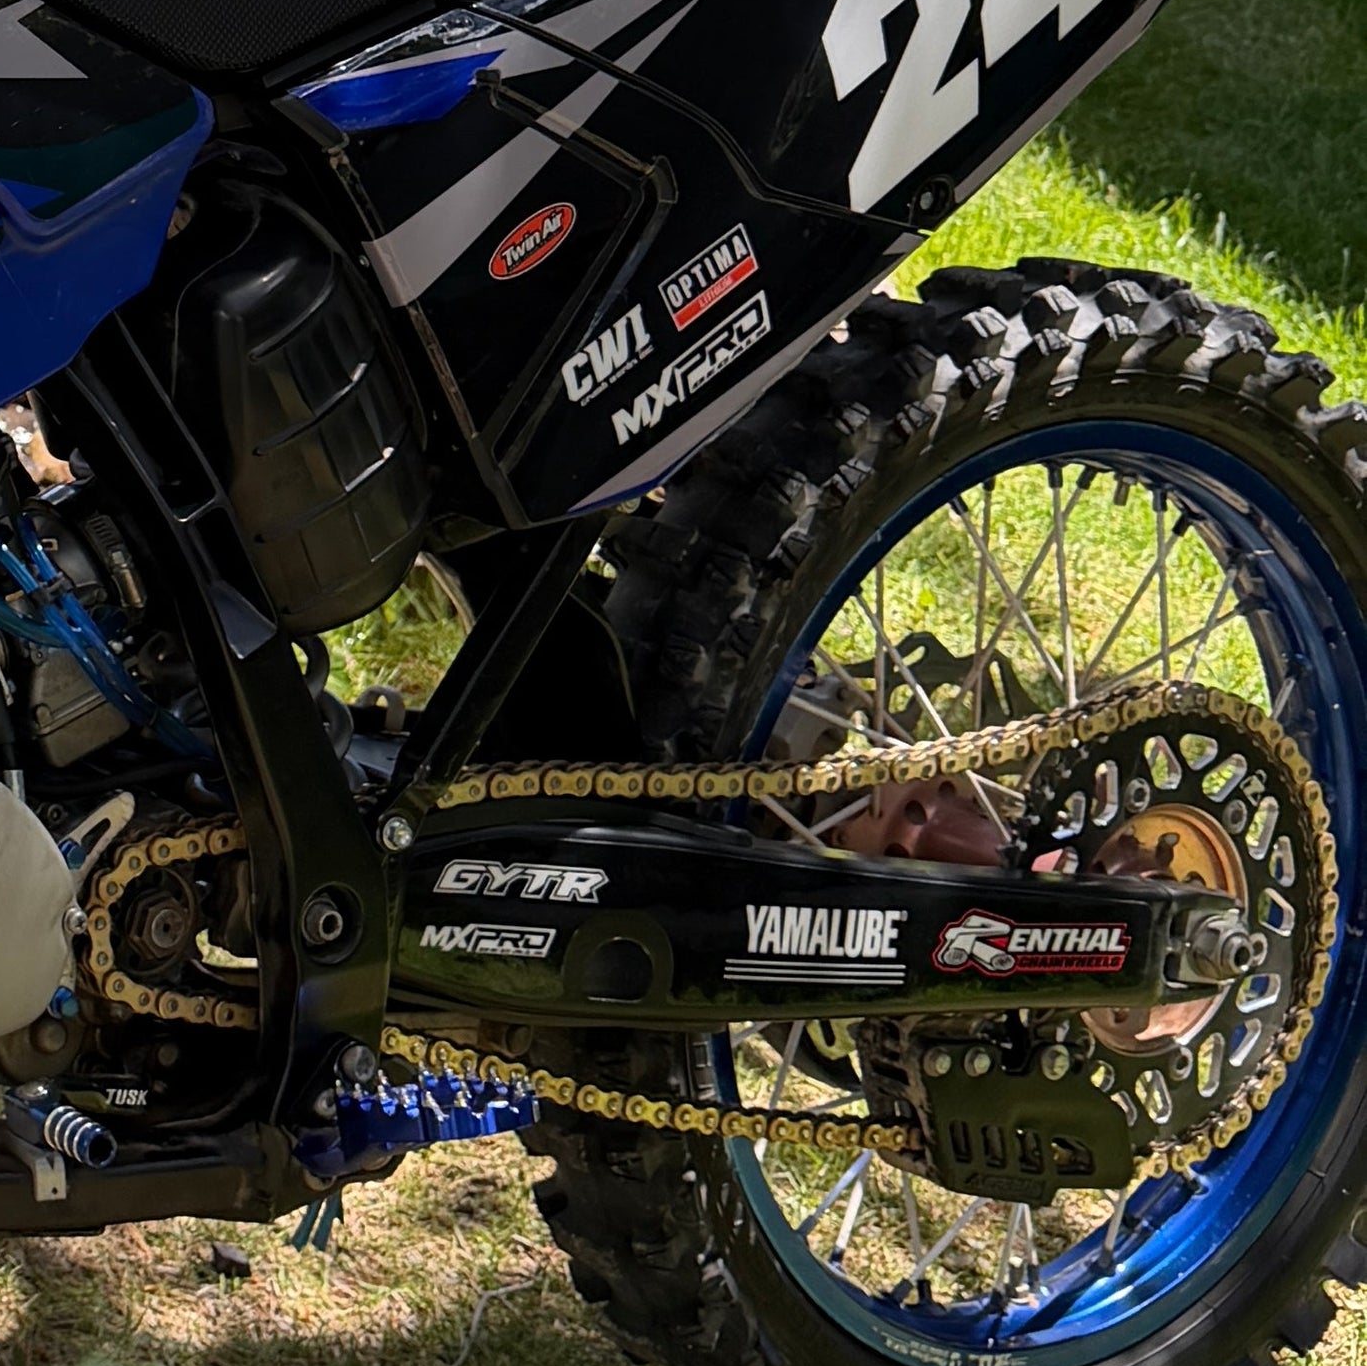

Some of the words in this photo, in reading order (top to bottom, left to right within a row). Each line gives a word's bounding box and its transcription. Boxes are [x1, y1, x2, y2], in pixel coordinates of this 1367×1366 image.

[500, 231, 541, 268] Twin
[541, 210, 564, 242] Air
[667, 233, 750, 309] OPTIMA
[434, 860, 608, 903] GYTR
[746, 904, 900, 958] YAMALUBE
[942, 914, 1127, 971] RENTHAL
[105, 1088, 148, 1106] TUSK
